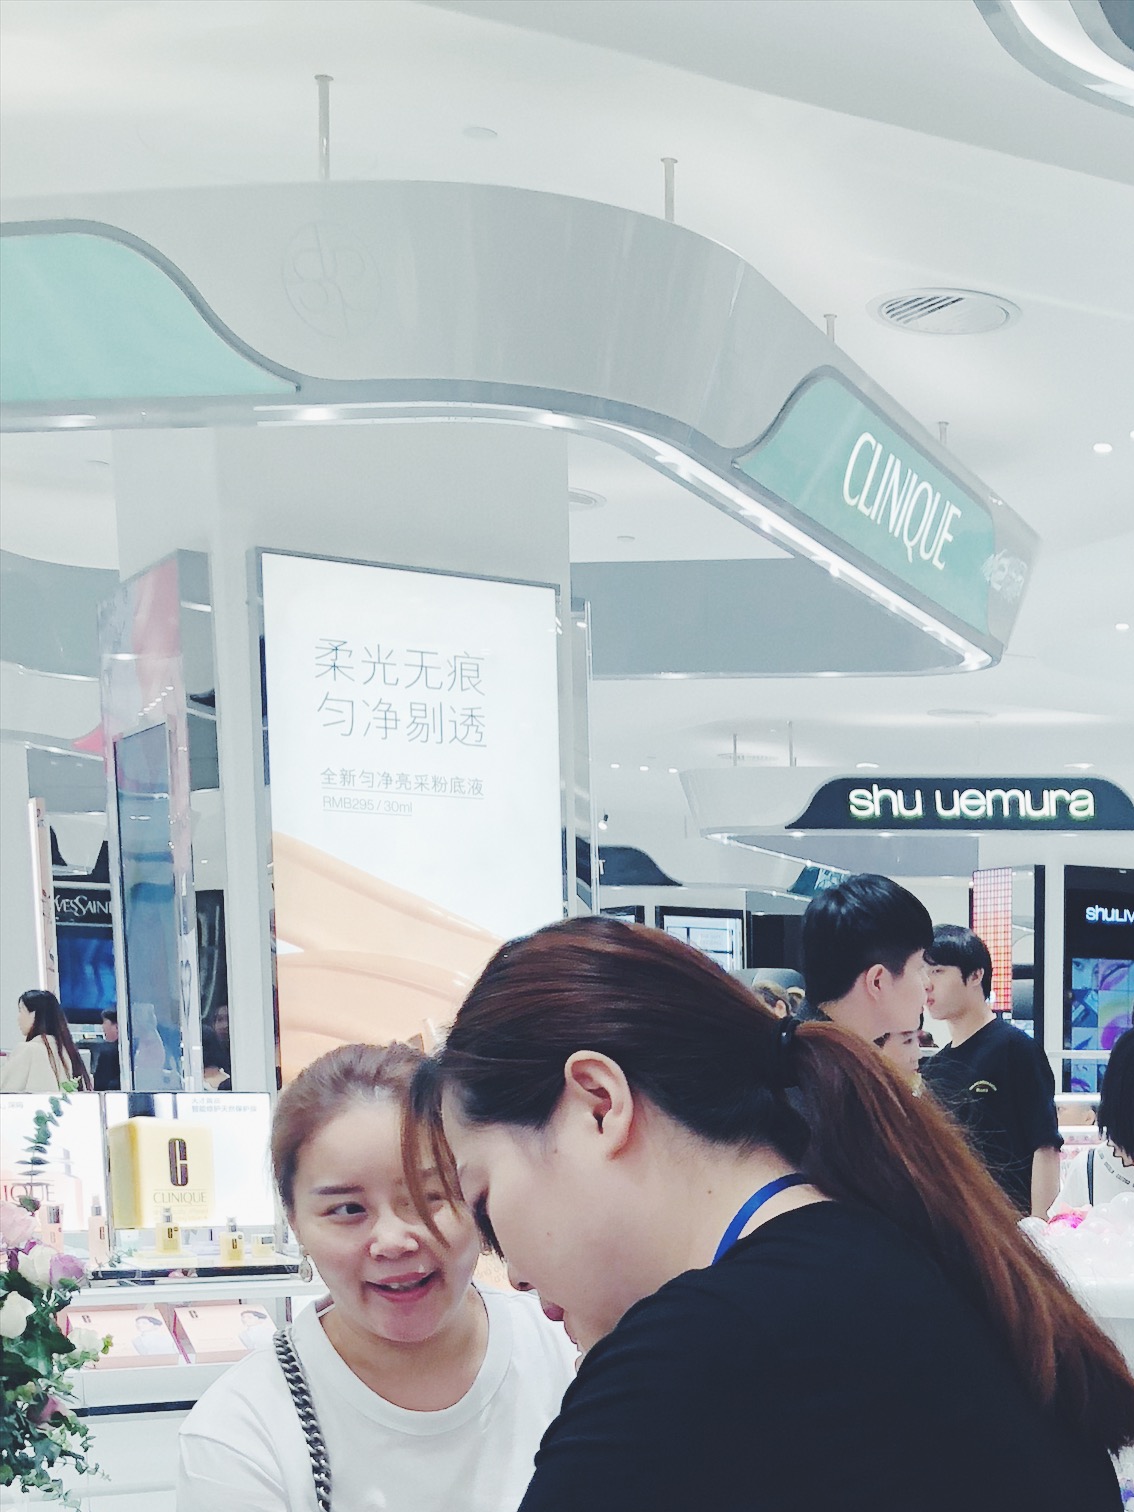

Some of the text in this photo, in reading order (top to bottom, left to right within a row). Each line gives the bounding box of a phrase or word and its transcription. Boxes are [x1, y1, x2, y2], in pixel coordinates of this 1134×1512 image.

[843, 432, 962, 570] CLINIQUE
[314, 637, 486, 696] 柔光无痕
[317, 691, 488, 748] 匀净剔透
[320, 767, 485, 797] 全新匀净亮采粉底液
[849, 784, 1095, 818] shu uemura
[153, 1191, 208, 1206] CLINIQUE
